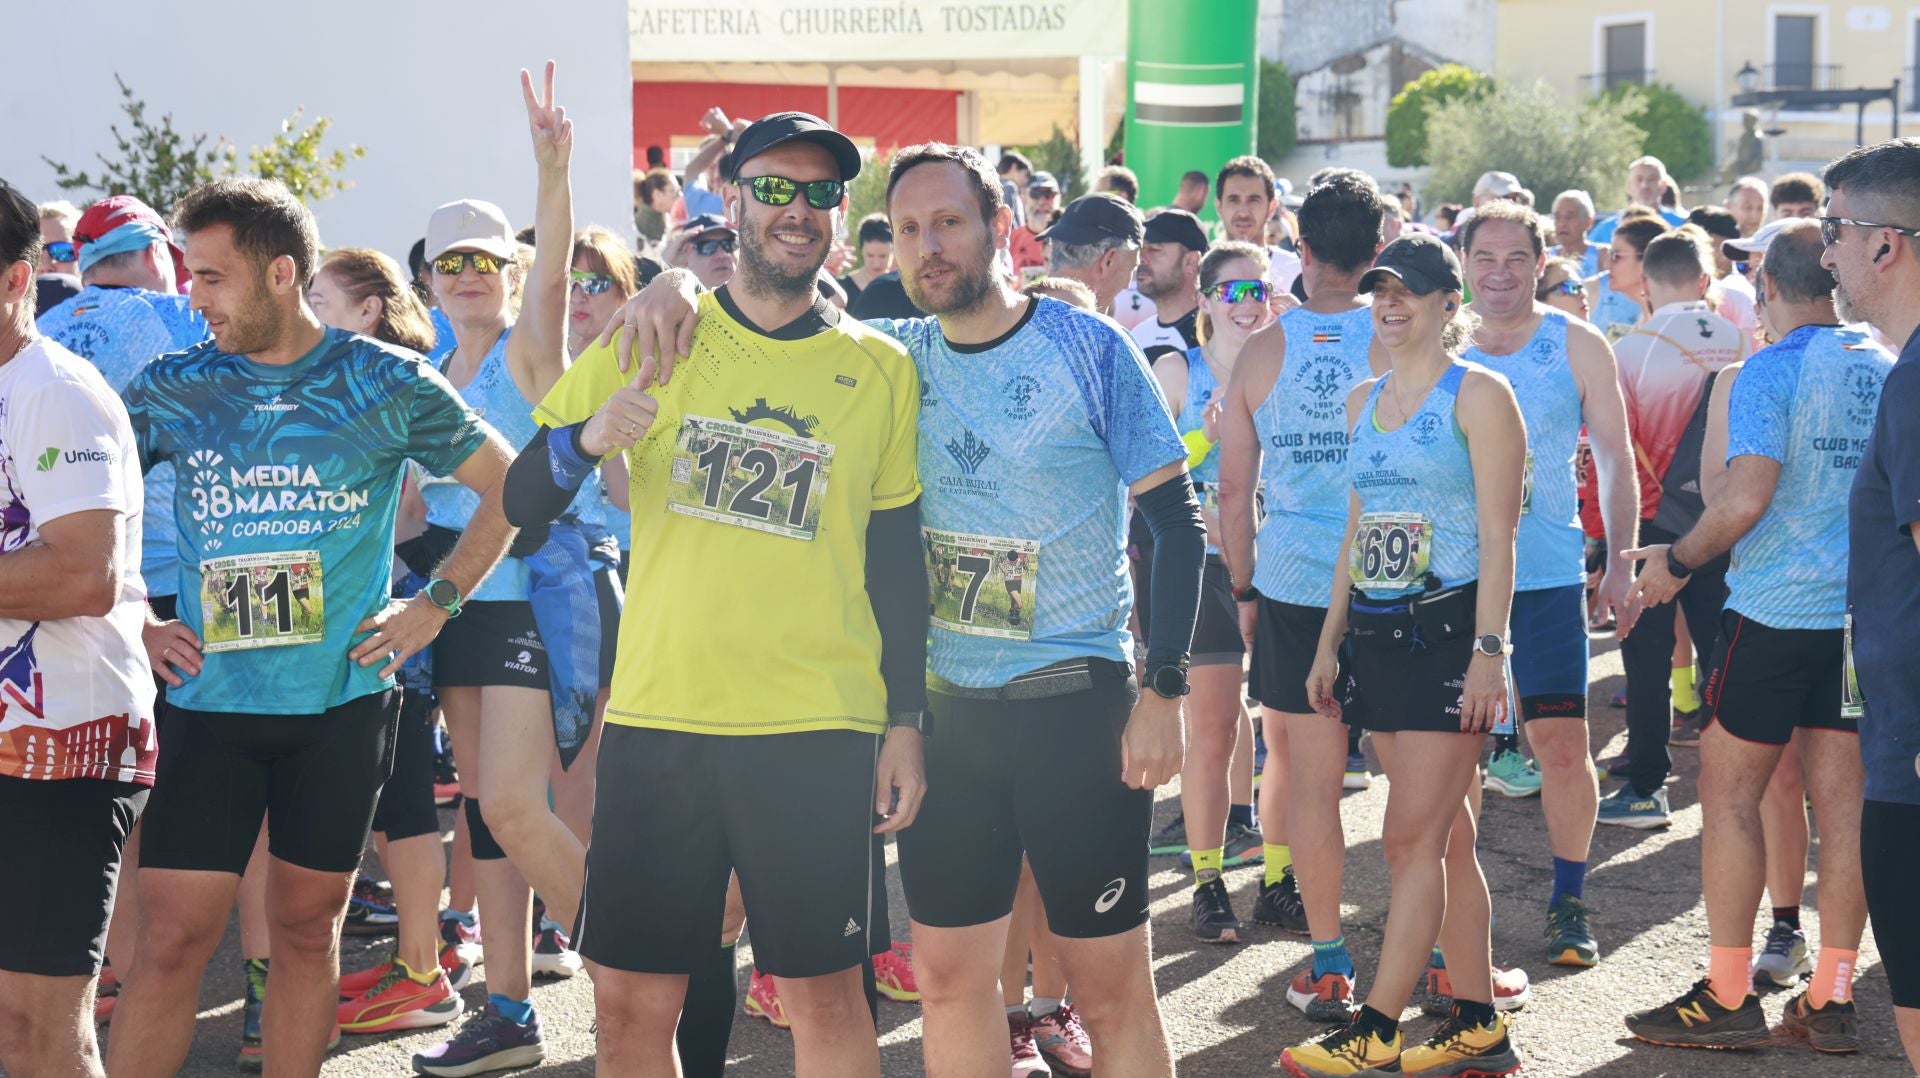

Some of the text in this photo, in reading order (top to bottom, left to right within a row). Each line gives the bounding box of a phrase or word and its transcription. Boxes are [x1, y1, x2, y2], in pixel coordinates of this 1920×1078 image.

[628, 4, 1066, 36] CAFETERIA CHURRERÍA TOSTADAS
[1294, 355, 1354, 383] CLUB MARATON
[253, 404, 300, 412] TEAMERGY
[705, 421, 743, 435] CROSS
[1272, 433, 1304, 448] CLUB
[1812, 438, 1848, 451] CLUB
[230, 463, 321, 488] MEDIA
[939, 476, 1000, 490] CAJA RURAL
[1359, 477, 1418, 489] EXTREMADURA
[697, 440, 818, 528] 121
[949, 488, 999, 499] EXTREMADURA
[191, 484, 369, 521] 38 MARATÓN
[232, 519, 323, 537] CORDOBA
[1363, 527, 1411, 580] 69
[214, 559, 236, 569] CROSS
[956, 554, 992, 623] 7
[227, 569, 293, 637] 11
[504, 660, 538, 675] VIATOR
